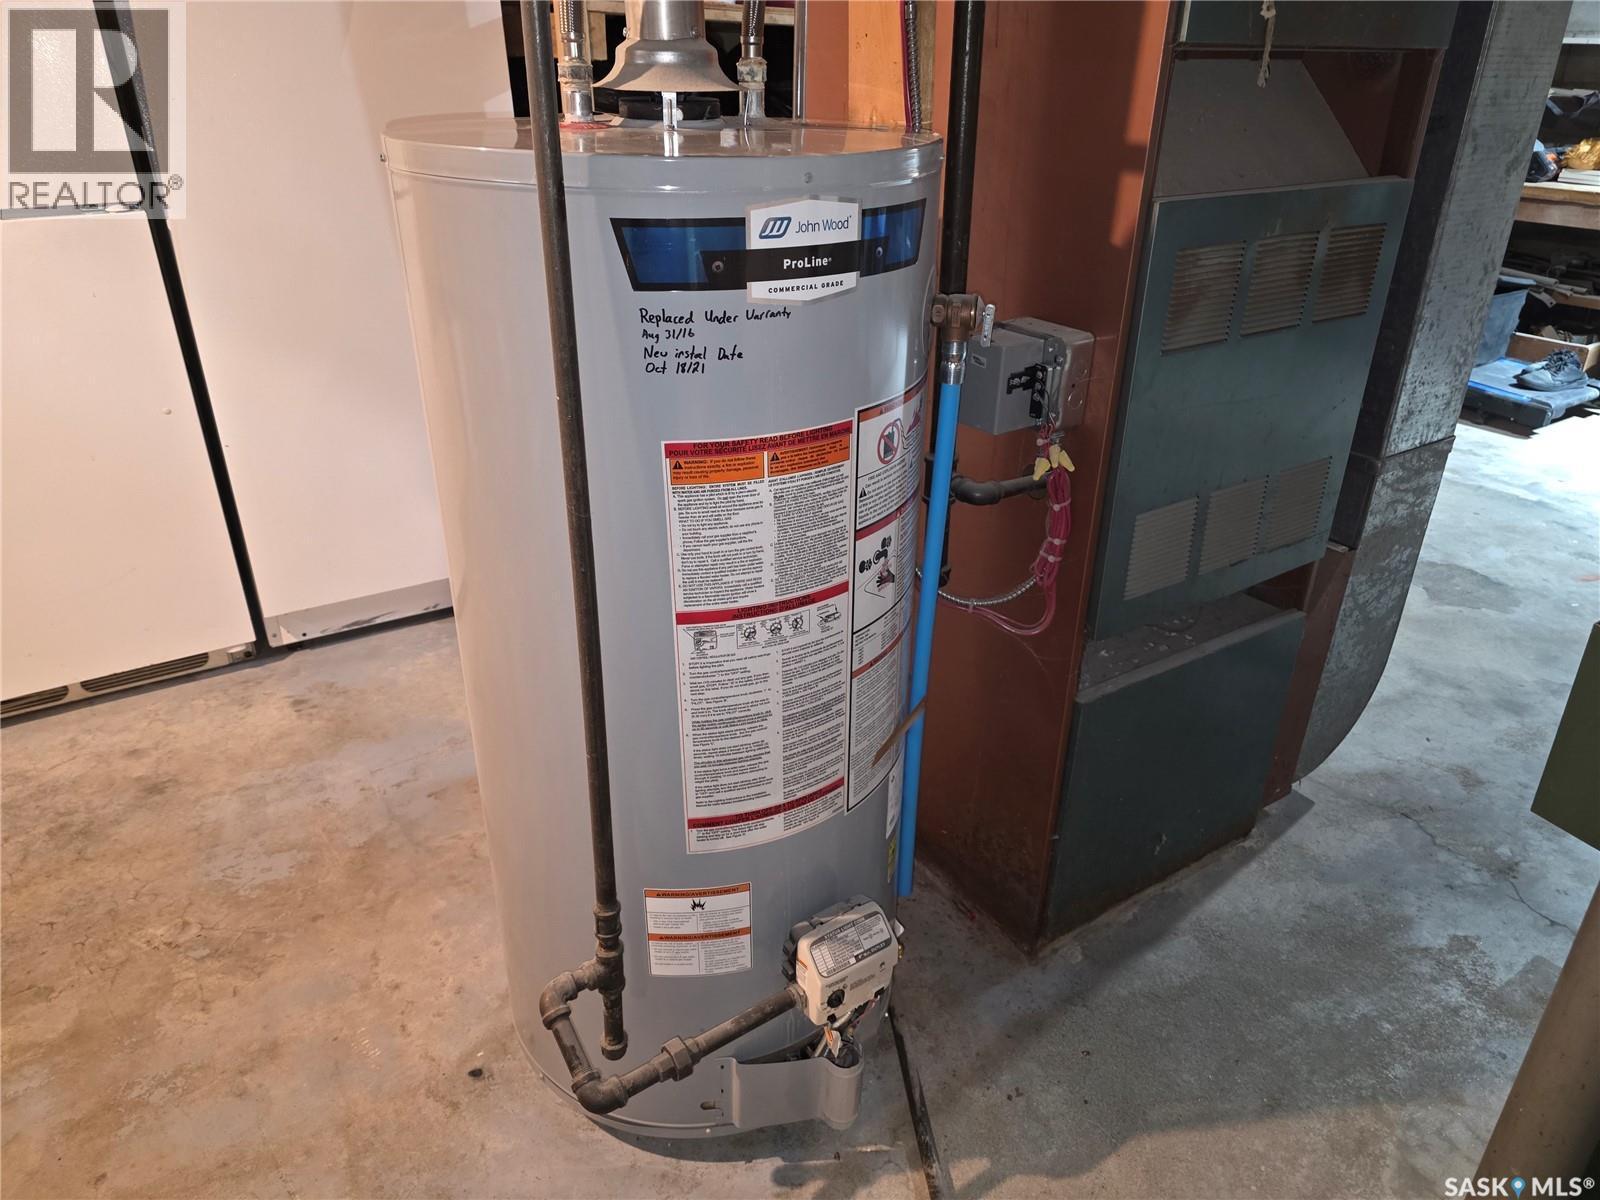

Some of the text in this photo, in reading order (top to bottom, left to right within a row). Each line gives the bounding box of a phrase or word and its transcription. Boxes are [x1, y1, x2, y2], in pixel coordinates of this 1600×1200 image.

[795, 220, 820, 234] John
[768, 280, 844, 294] COMMERCIAL GRADE
[639, 307, 695, 327] Replaced
[704, 309, 739, 325] Under
[641, 327, 696, 344] Aug 31/16
[717, 344, 744, 361] Date
[645, 361, 705, 375] Oct 18/21
[693, 442, 708, 450] FOR
[709, 440, 729, 449] YOUR
[732, 438, 758, 447] SAFETY
[760, 435, 778, 443] READ
[780, 432, 804, 441] BEFORE
[669, 449, 688, 457] POUR
[691, 448, 712, 456] VOTRE
